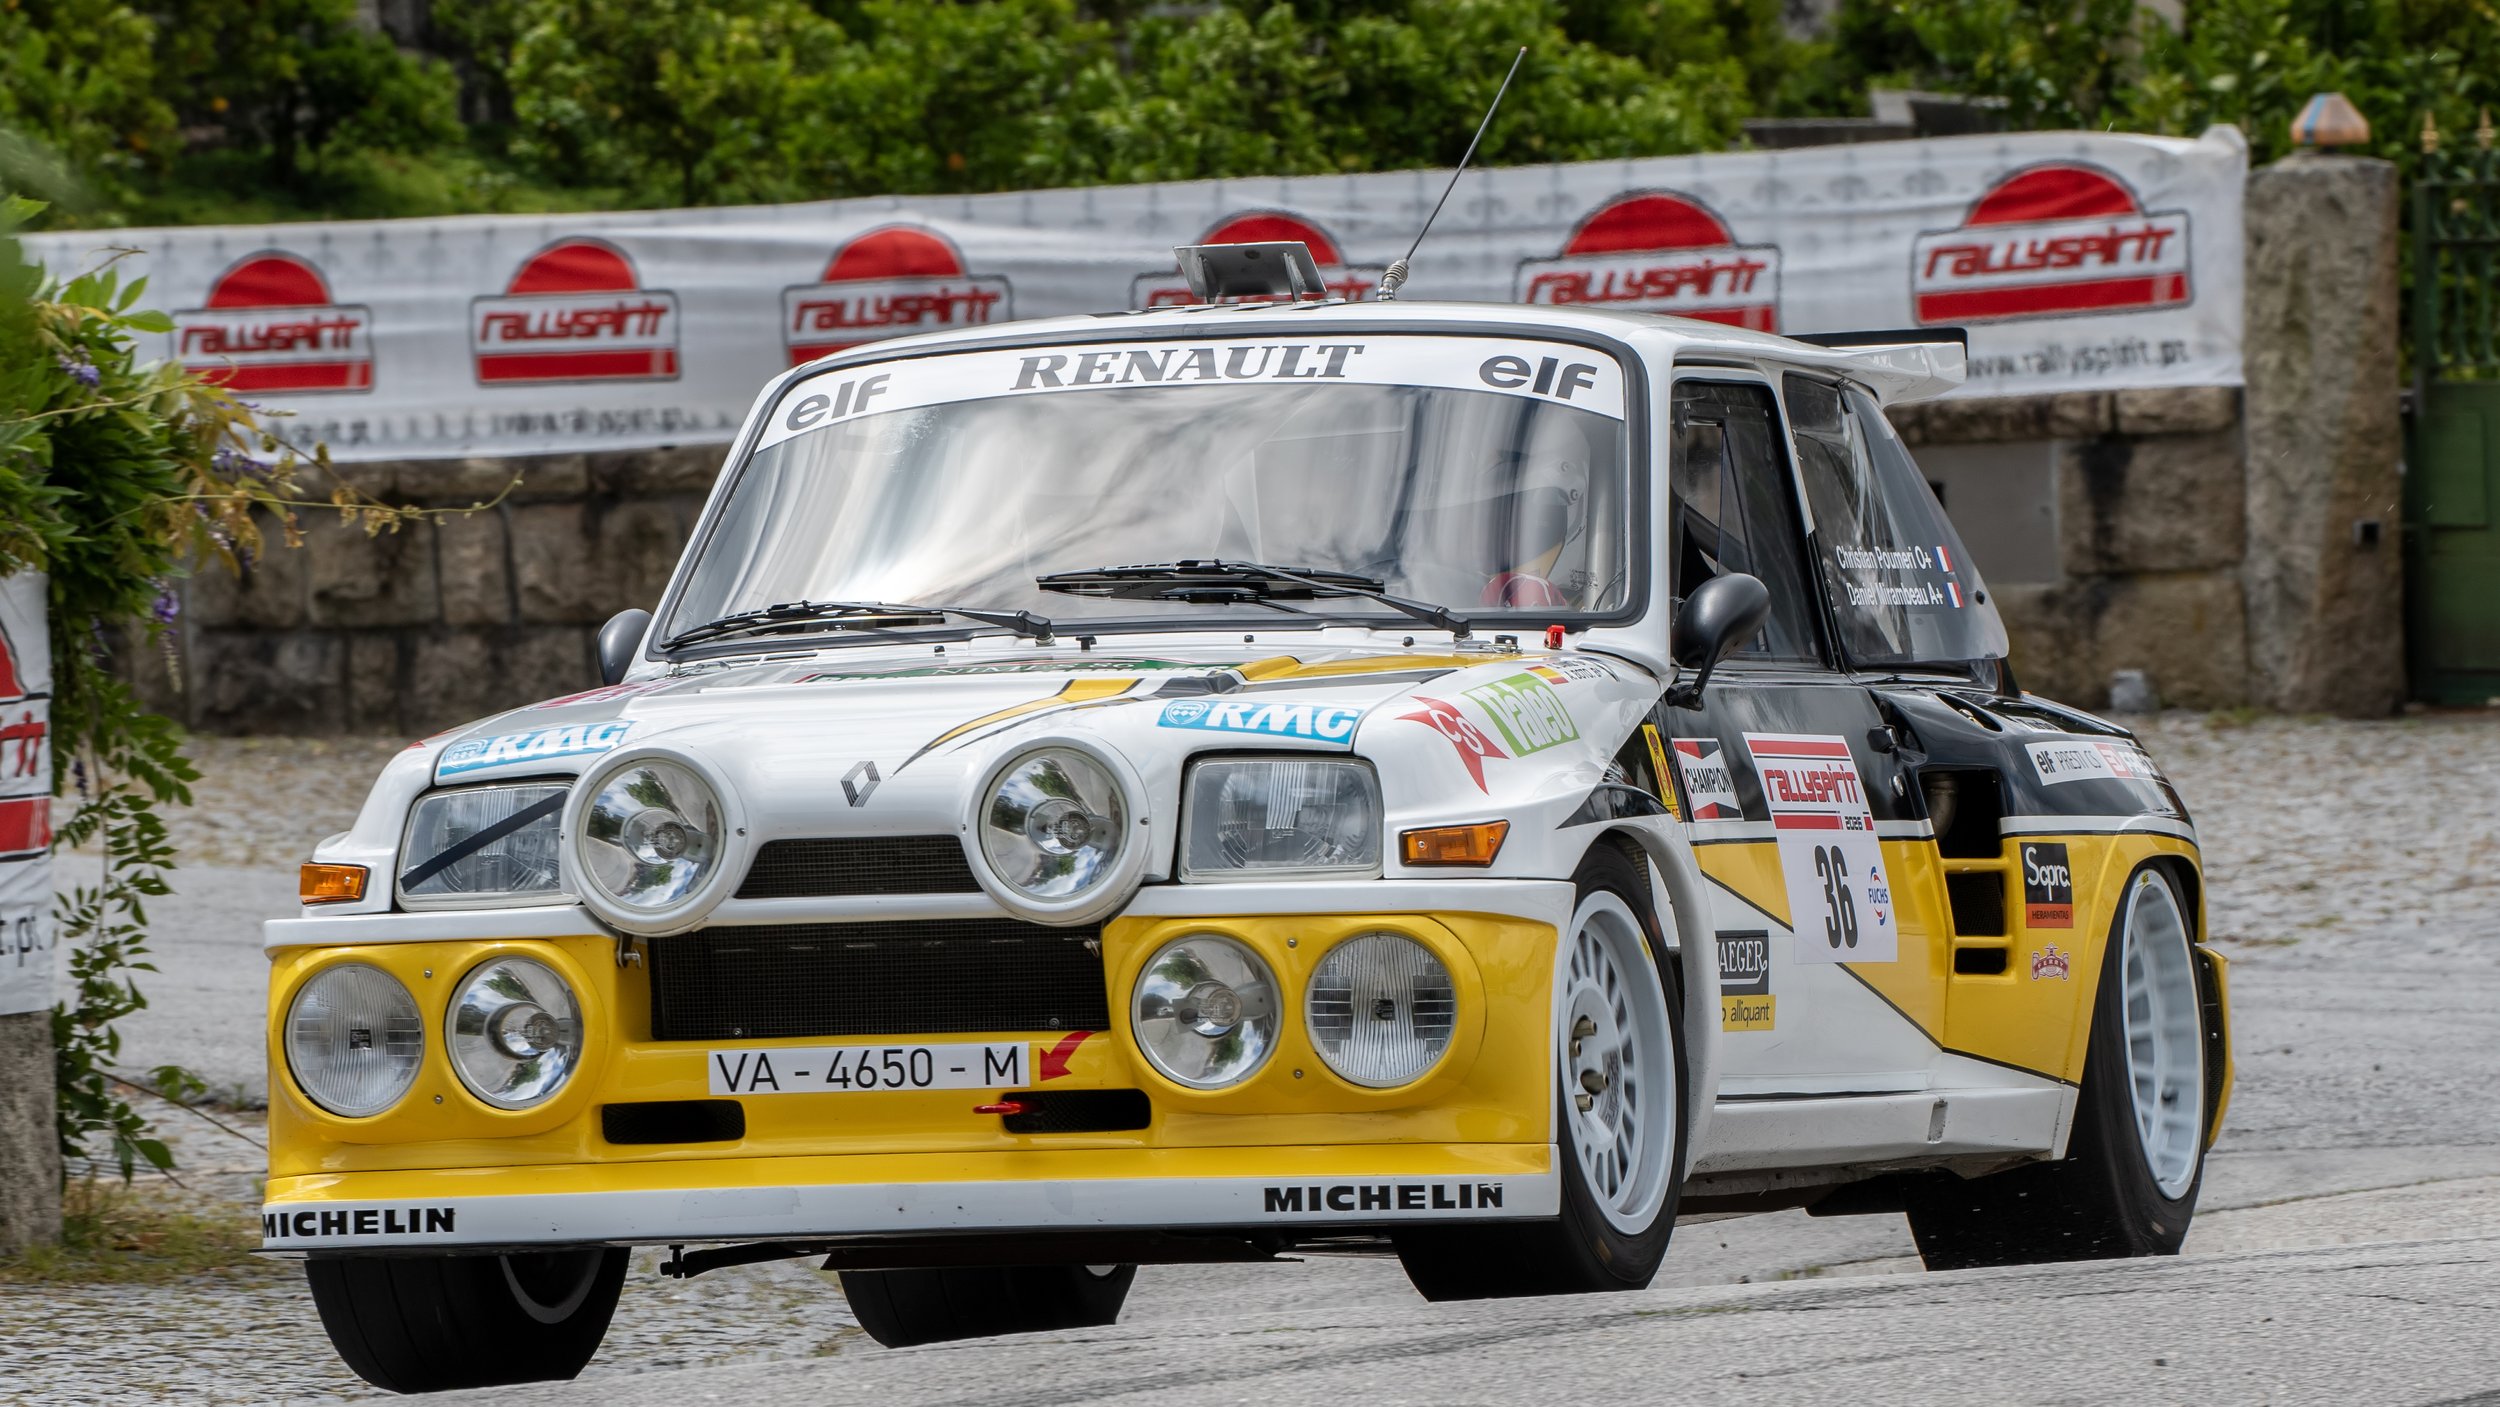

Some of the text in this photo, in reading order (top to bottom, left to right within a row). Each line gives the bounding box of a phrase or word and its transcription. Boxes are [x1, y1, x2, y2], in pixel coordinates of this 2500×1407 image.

[1925, 225, 2175, 278] rallyspirit
[481, 300, 668, 342] rallyspirit
[1009, 344, 1364, 391] RENAULT
[1479, 354, 1598, 400] elf
[786, 374, 891, 432] elf
[1836, 545, 1878, 569] Christian
[1846, 582, 1879, 606] Daniel
[1205, 702, 1359, 738] RMC
[1429, 709, 1485, 755] CS
[484, 721, 630, 764] RMC
[2036, 750, 2056, 774] elf
[1684, 767, 1734, 794] CHAMPION
[1764, 763, 1859, 803] rallyspirit
[1814, 845, 1858, 949] 36
[1868, 887, 1889, 904] FUCHS
[1730, 999, 1770, 1028] alliquant
[716, 1052, 780, 1092] VA
[825, 1048, 933, 1090] 4650
[985, 1046, 1019, 1086] M
[1264, 1183, 1504, 1213] MICHELIN
